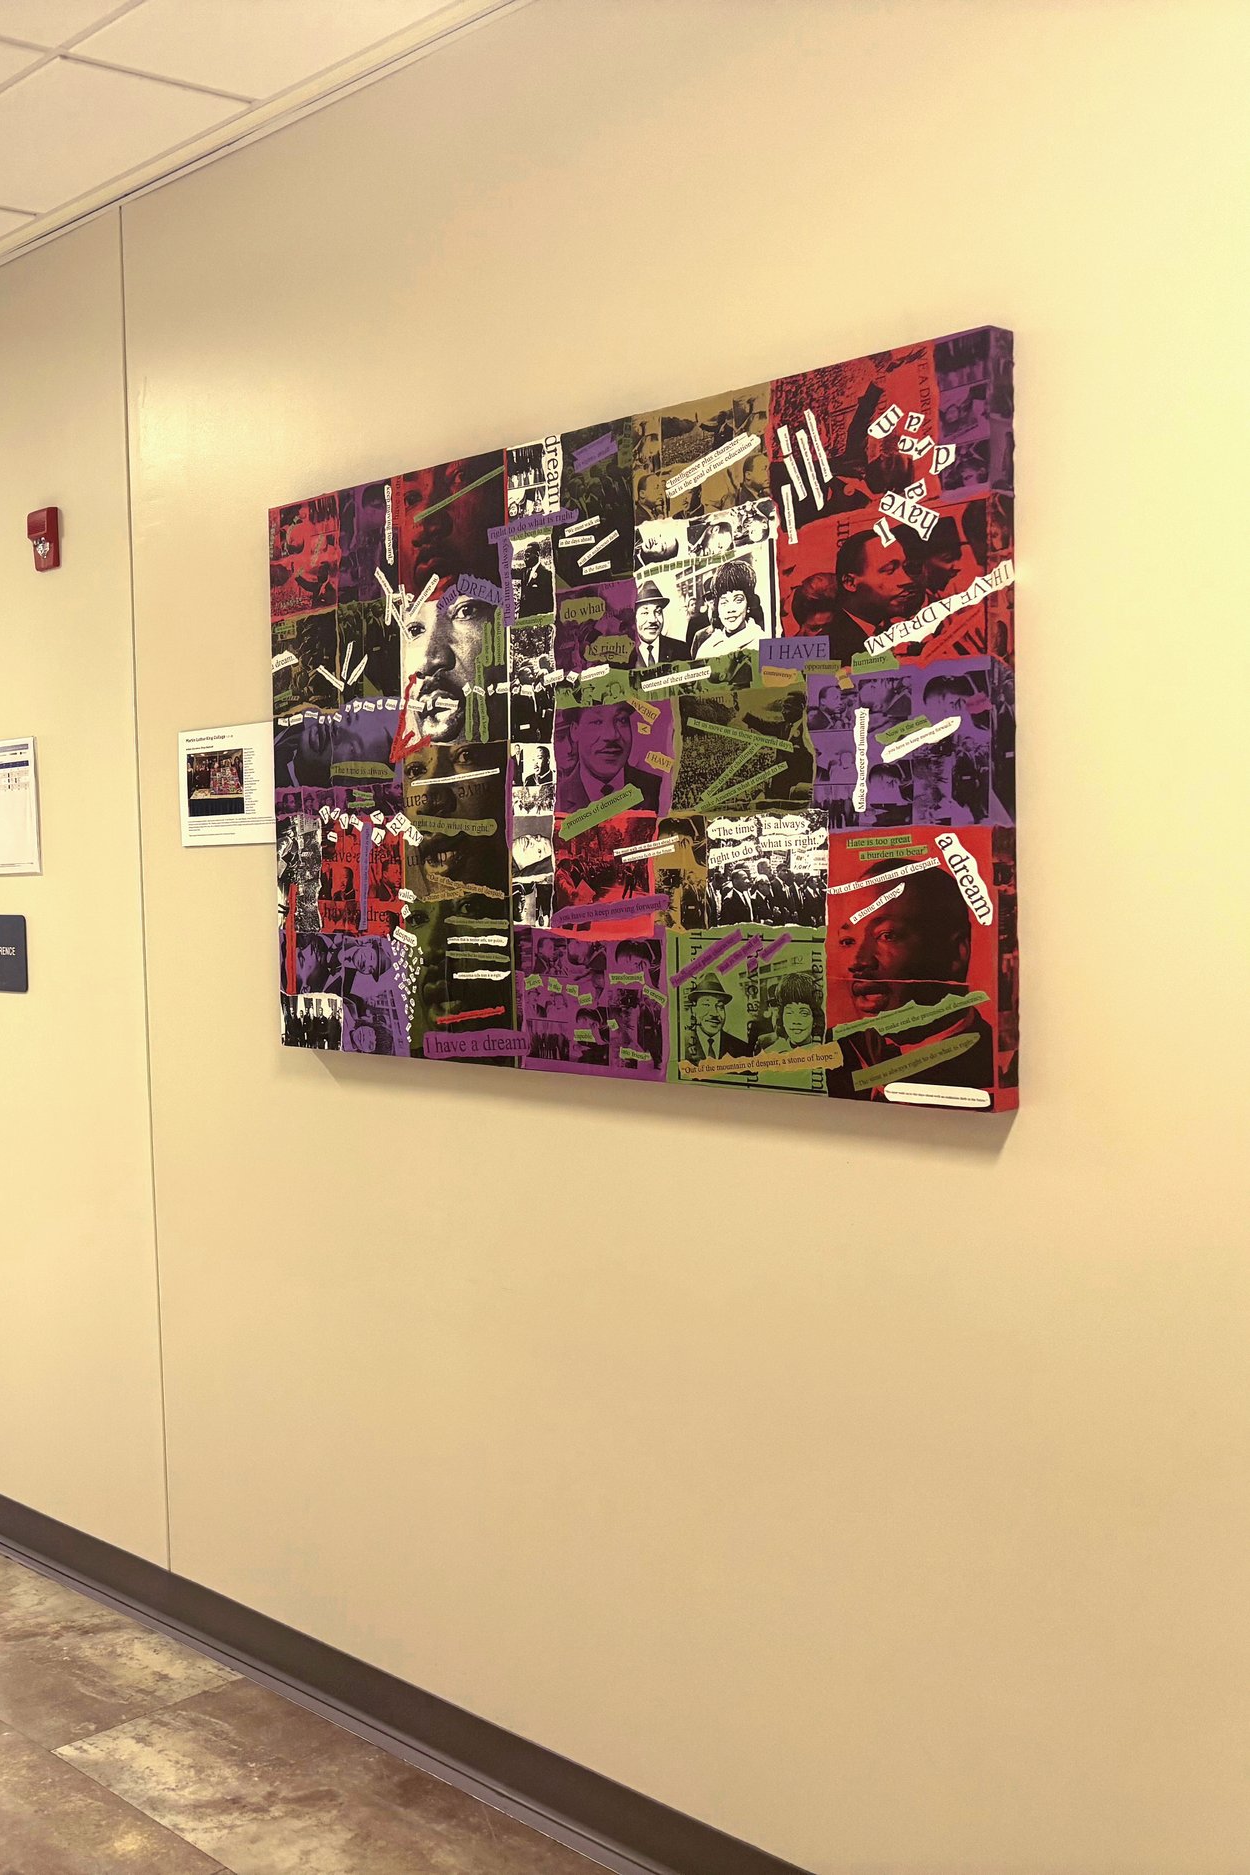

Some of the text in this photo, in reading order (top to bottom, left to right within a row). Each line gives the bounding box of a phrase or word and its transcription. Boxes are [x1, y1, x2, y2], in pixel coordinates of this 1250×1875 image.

[701, 456, 714, 467] plus
[544, 435, 561, 513] dream.
[683, 480, 693, 488] the
[693, 470, 705, 483] goal
[706, 466, 713, 474] of
[712, 460, 724, 470] true
[906, 481, 924, 498] a
[880, 494, 938, 539] have
[490, 528, 507, 539] right
[517, 522, 527, 531] do
[528, 518, 546, 530] what
[547, 516, 553, 524] is
[501, 538, 511, 603] time is always
[564, 602, 605, 619] do what
[867, 569, 1003, 654] HAVE A DREAM
[769, 643, 827, 660] I HAVE
[804, 663, 840, 671] opportunity
[643, 681, 662, 689] content
[670, 675, 684, 684] their
[684, 670, 710, 680] character
[708, 724, 778, 746] move these powerful
[858, 709, 866, 746] humanity.
[886, 719, 928, 737] Now time
[920, 730, 935, 740] moving
[651, 753, 672, 768] HAVE
[858, 748, 865, 757] of
[715, 772, 769, 803] America what ought
[566, 788, 633, 829] promises of democracy
[735, 824, 755, 833] time
[764, 820, 805, 830] is always
[760, 838, 782, 848] what
[784, 837, 792, 846] is
[847, 835, 910, 848] Hate is too great
[710, 846, 753, 864] right to do
[866, 850, 894, 859] burden
[896, 849, 904, 857] to
[852, 880, 864, 889] the
[866, 871, 898, 887] mountain
[900, 865, 910, 875] of
[938, 836, 991, 925] a dream.
[399, 891, 416, 900] valley
[571, 904, 635, 920] have keep moving
[858, 904, 875, 919] stone
[876, 897, 884, 907] of
[885, 1023, 899, 1032] make
[911, 1015, 920, 1023] the
[920, 1007, 945, 1020] promises
[425, 1038, 430, 1053] I
[435, 1037, 464, 1052] have
[471, 1041, 481, 1050] a
[705, 1063, 716, 1072] the
[717, 1062, 745, 1072] mountain
[748, 1060, 755, 1068] of
[787, 1056, 805, 1064] stone
[807, 1053, 815, 1061] of
[889, 1064, 908, 1076] always
[908, 1058, 922, 1068] right
[930, 1052, 938, 1060] do
[939, 1046, 952, 1056] what
